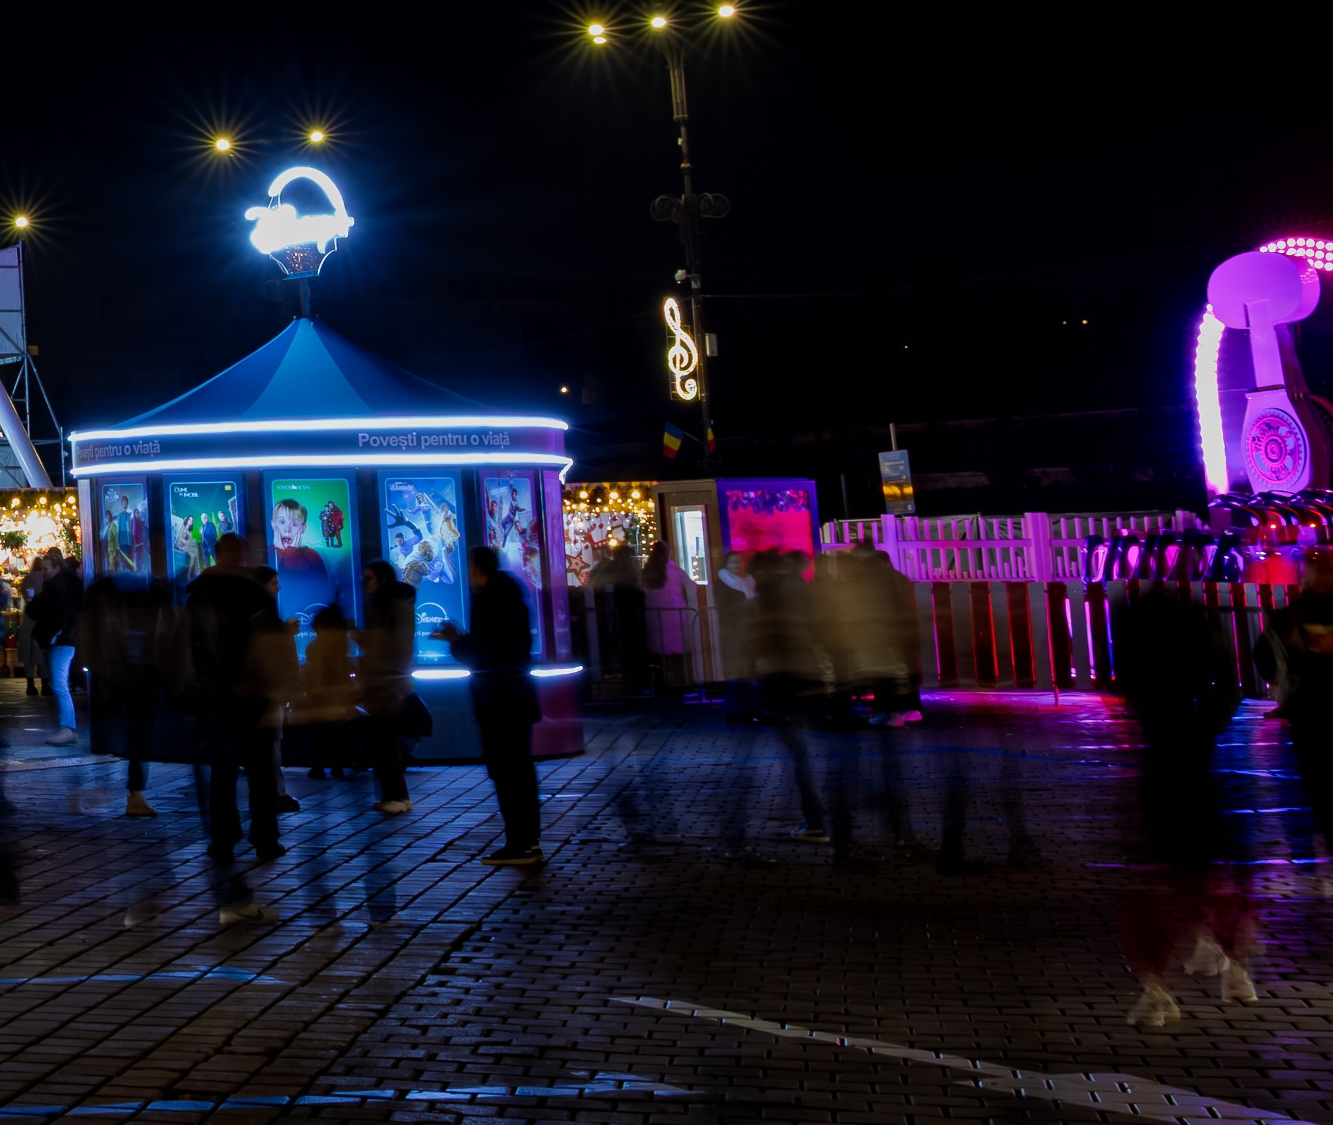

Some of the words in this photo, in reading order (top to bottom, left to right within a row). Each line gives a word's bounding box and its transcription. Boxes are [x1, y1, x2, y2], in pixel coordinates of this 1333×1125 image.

[95, 442, 122, 461] pentru
[124, 446, 131, 456] o
[133, 439, 162, 458] viață
[358, 431, 417, 451] Povești
[421, 433, 468, 450] pentru
[470, 434, 480, 446] o
[482, 430, 511, 450] viață
